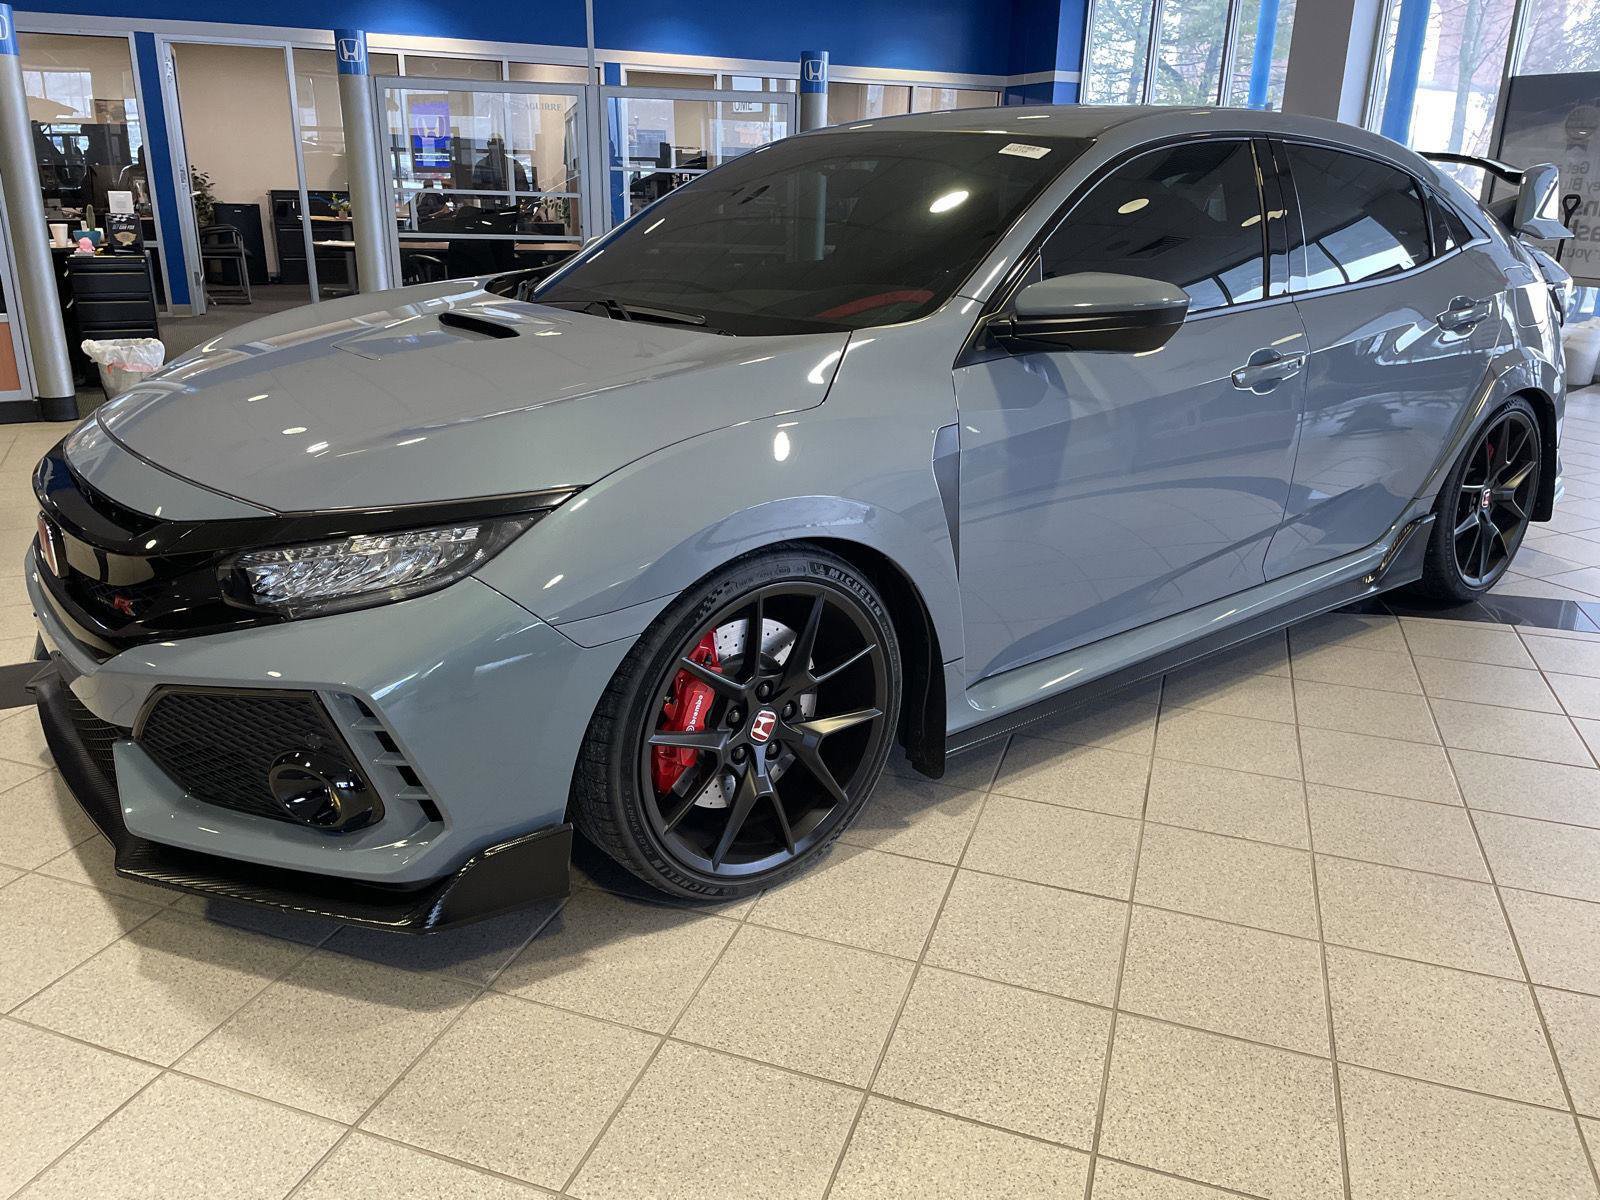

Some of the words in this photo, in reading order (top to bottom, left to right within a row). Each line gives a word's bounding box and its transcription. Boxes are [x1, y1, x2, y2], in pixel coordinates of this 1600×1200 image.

[829, 568, 882, 616] MICHELIN
[690, 694, 704, 725] brembo
[651, 859, 720, 896] MICHELIN
